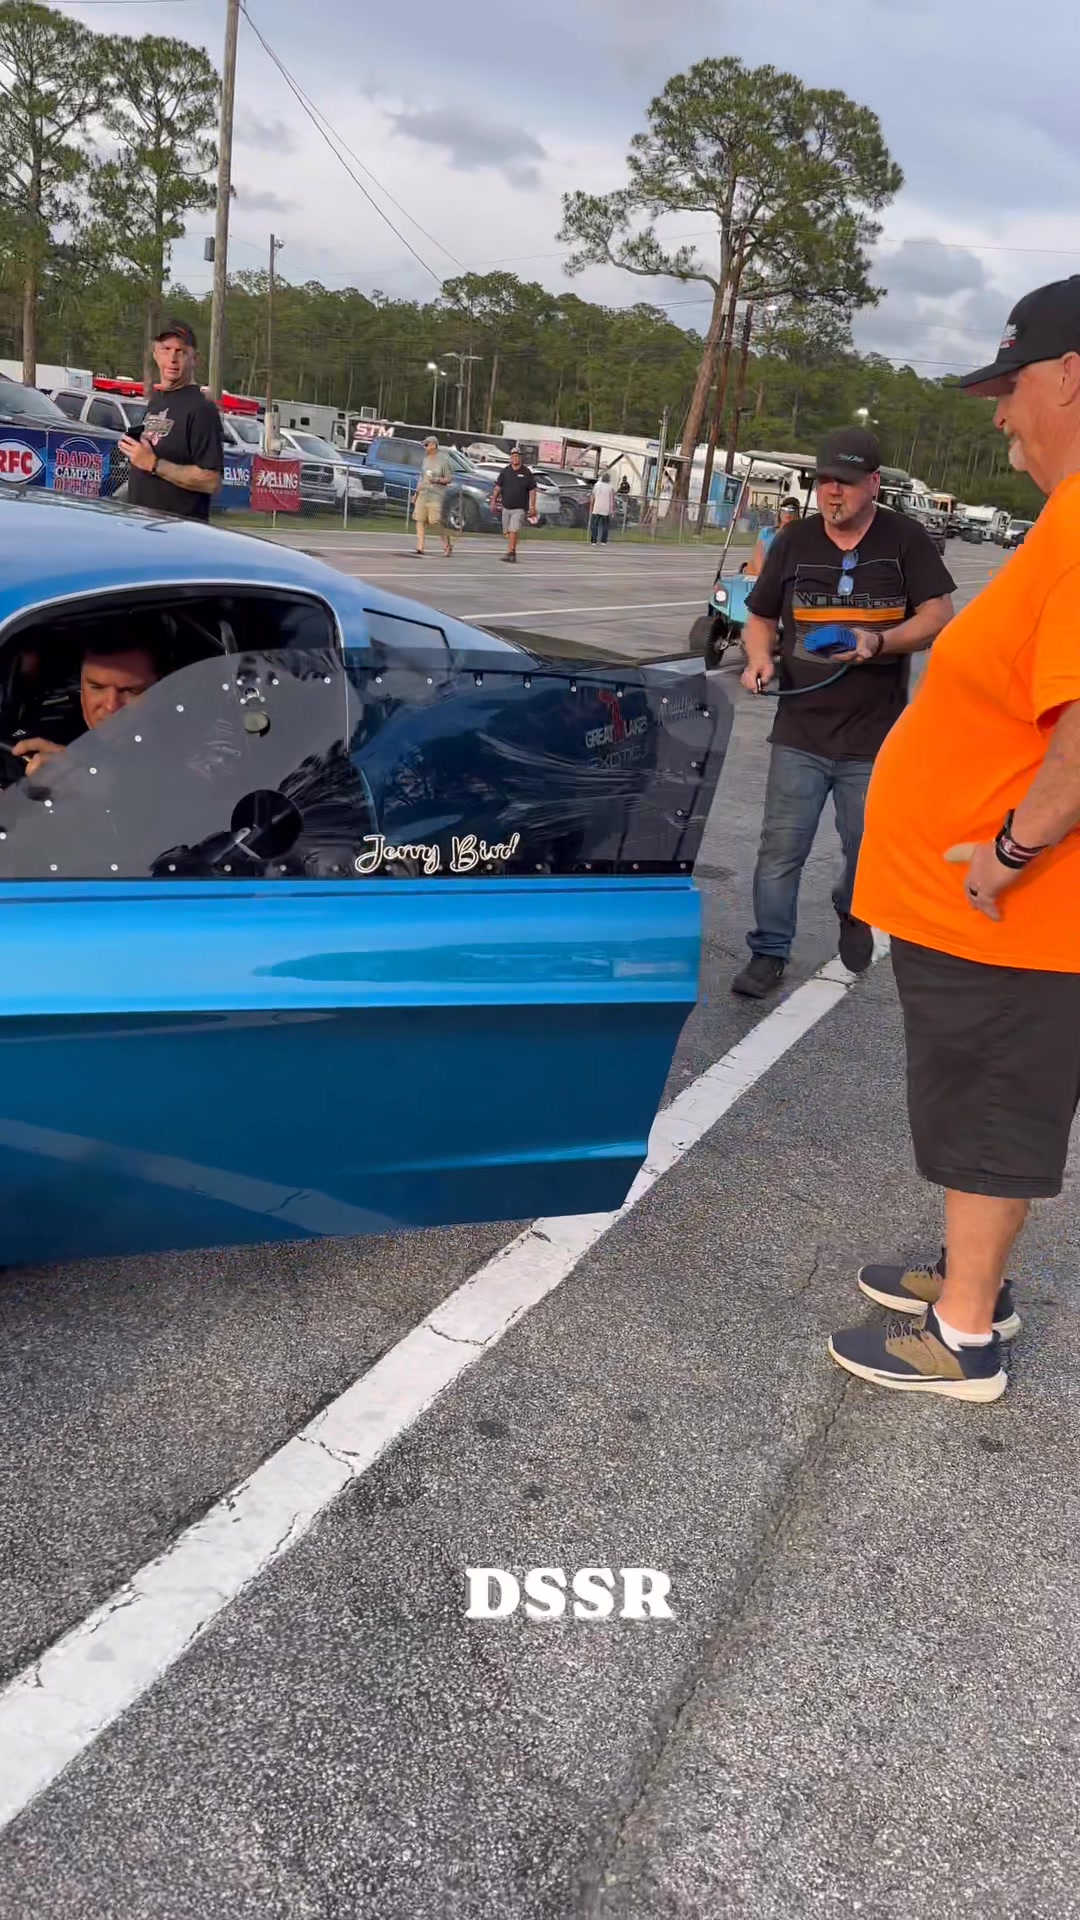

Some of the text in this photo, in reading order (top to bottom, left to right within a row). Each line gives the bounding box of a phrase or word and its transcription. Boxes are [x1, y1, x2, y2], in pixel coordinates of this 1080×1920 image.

[354, 422, 395, 438] STM
[55, 448, 102, 470] DAD'S
[55, 466, 102, 482] CAMPER
[223, 466, 250, 482] ELLING
[256, 468, 298, 489] MELLING
[585, 723, 614, 749] GREAT
[354, 832, 520, 874] Jerry Bird
